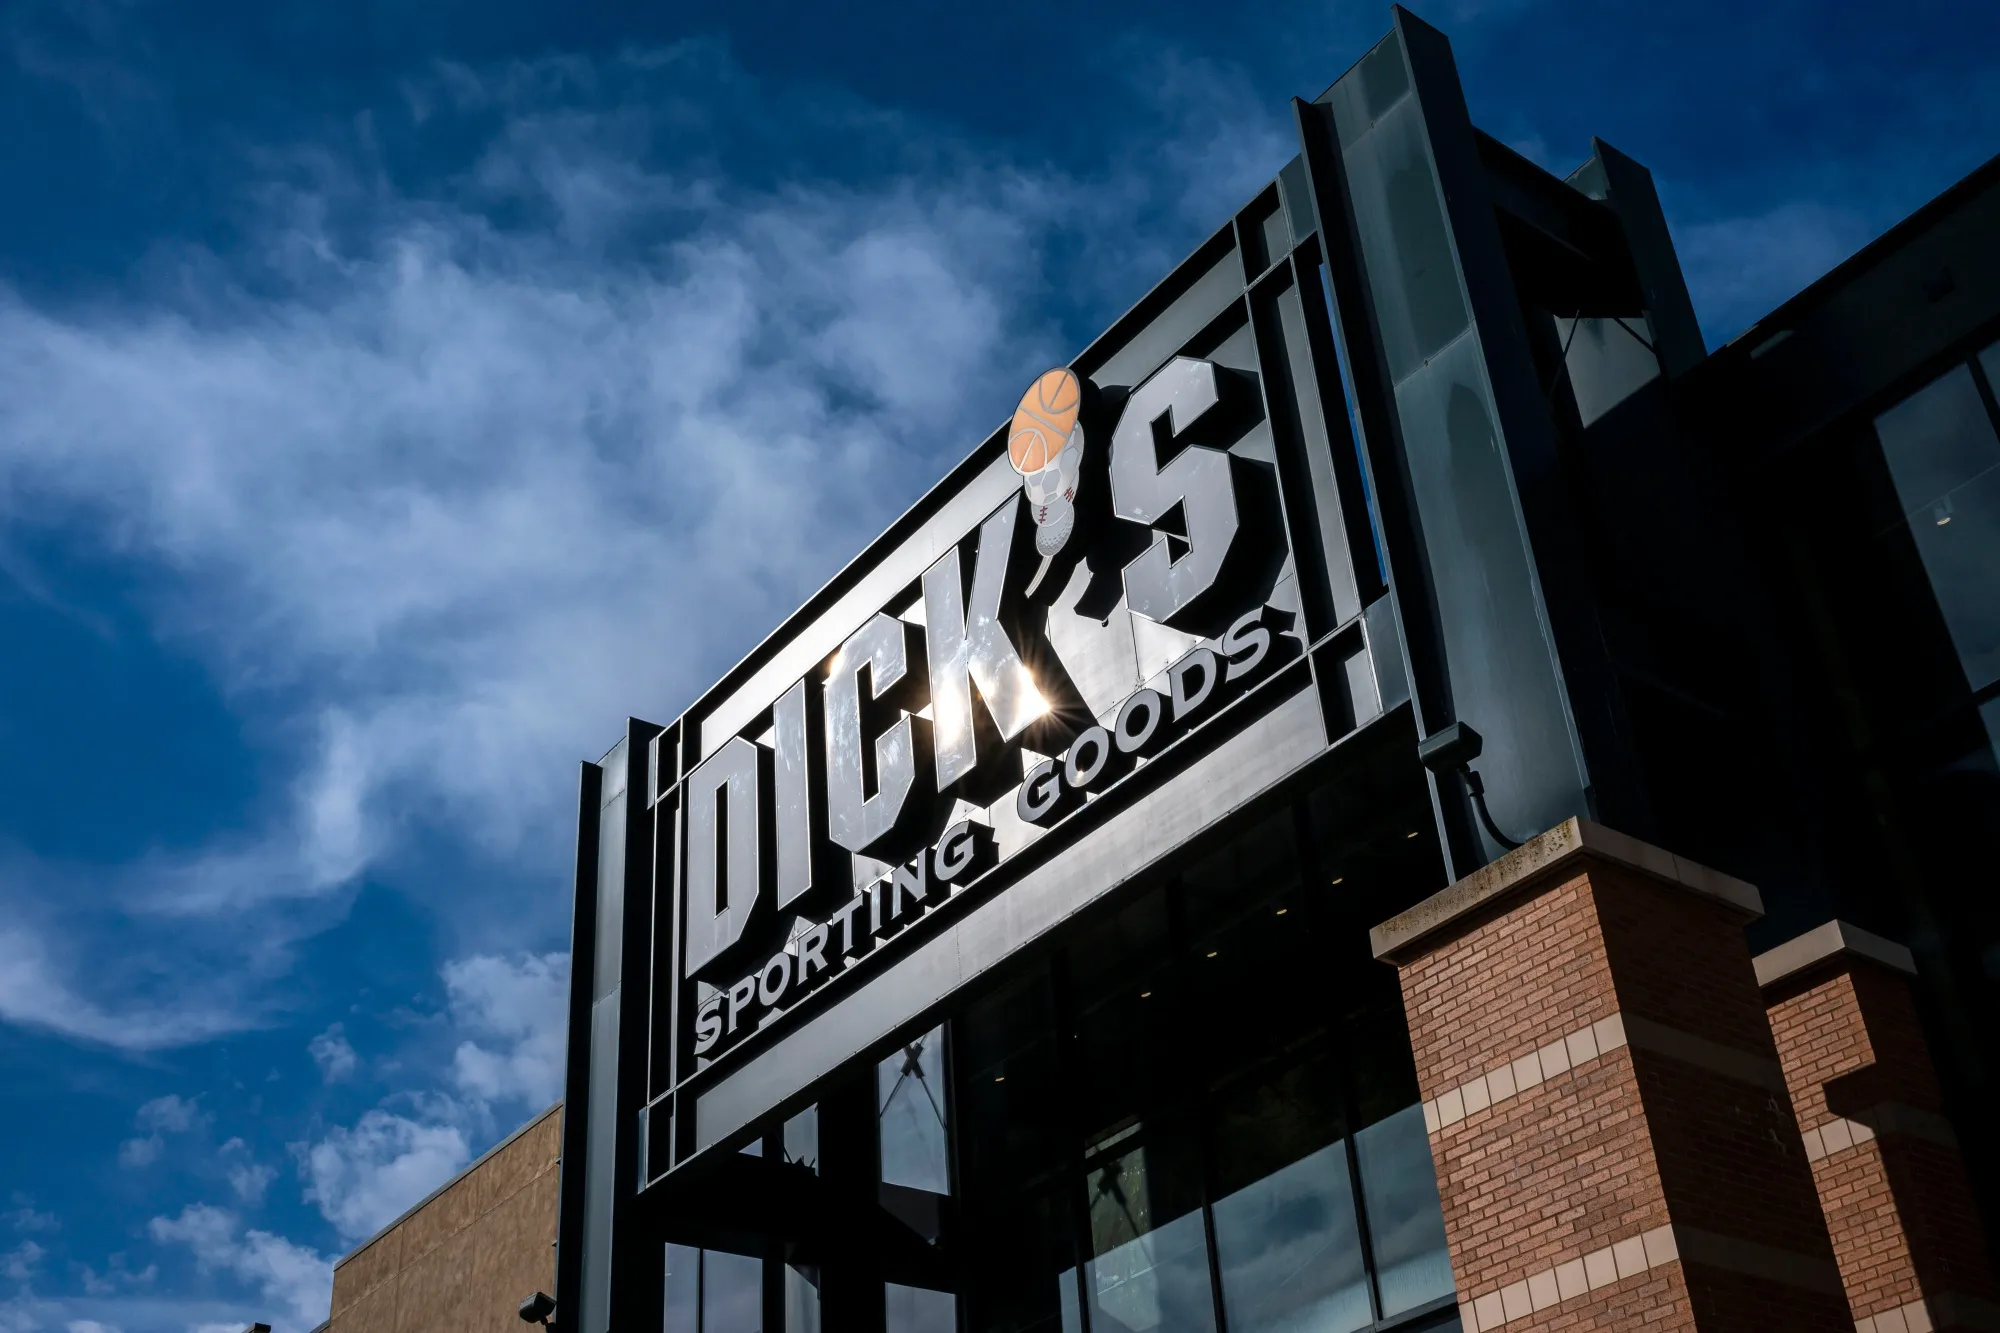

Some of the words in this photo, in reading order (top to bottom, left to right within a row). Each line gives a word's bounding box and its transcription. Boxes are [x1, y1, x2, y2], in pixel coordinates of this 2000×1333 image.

[686, 356, 1239, 979] DICK'S
[694, 820, 975, 1055] SPORTING
[1017, 607, 1270, 823] GOODS
